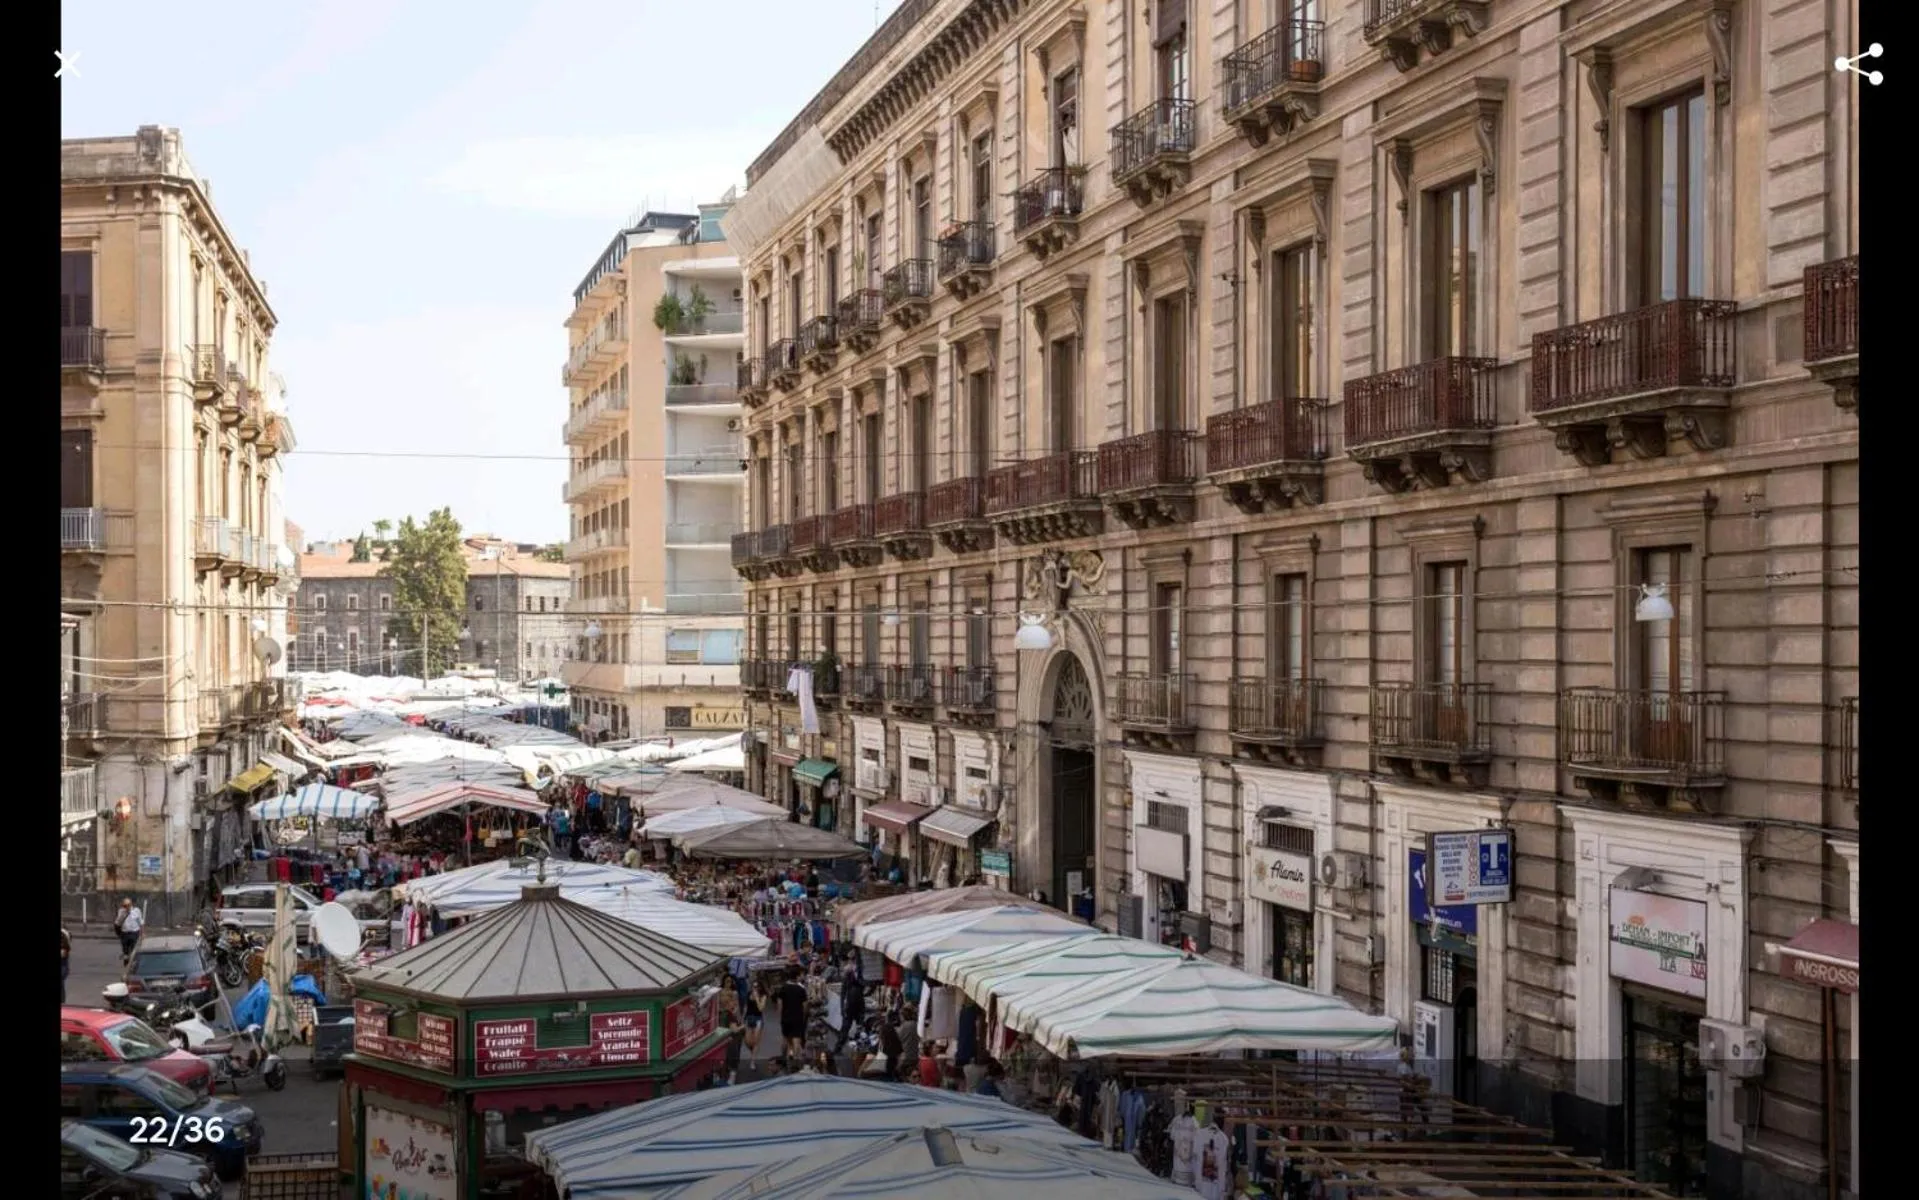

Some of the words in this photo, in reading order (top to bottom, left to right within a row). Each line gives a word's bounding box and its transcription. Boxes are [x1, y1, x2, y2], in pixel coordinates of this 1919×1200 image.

[1657, 930, 1690, 946] IMPORT
[607, 1017, 632, 1027] Seltz
[483, 1023, 528, 1035] Frullati
[601, 1040, 641, 1051] Arancia
[488, 1048, 522, 1059] Wafer
[483, 1060, 527, 1072] Granite
